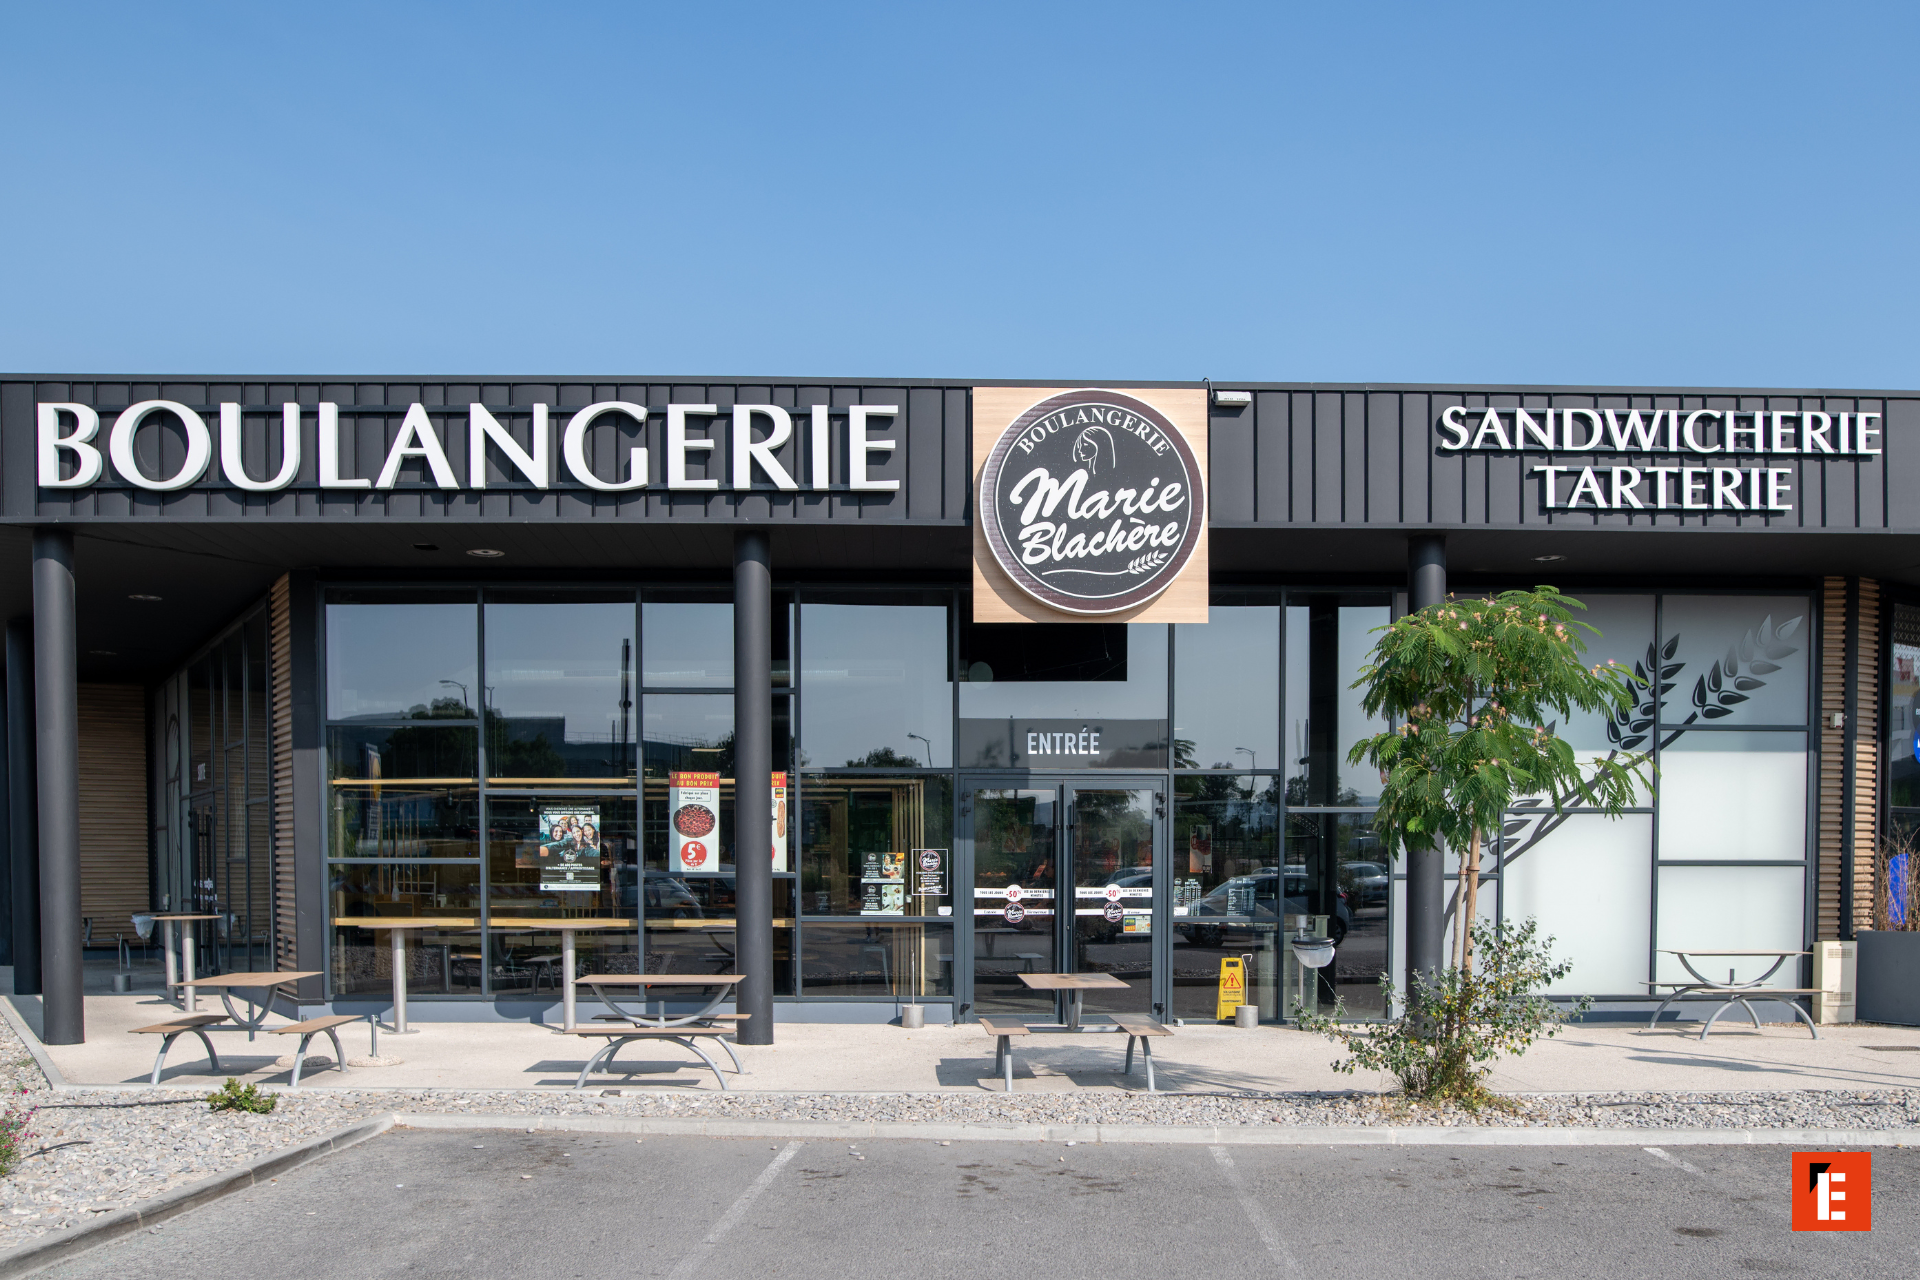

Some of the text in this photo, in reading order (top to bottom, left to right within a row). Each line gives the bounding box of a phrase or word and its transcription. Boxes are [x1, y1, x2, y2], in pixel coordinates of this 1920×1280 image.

[37, 400, 900, 491] BOULANGERIE
[1017, 407, 1170, 456] BOULANGERIE
[1441, 405, 1882, 455] SANDWICHERIE
[1010, 467, 1185, 526] Marie
[1533, 464, 1793, 511] TARTERIE
[1018, 517, 1181, 565] Blachère
[1027, 727, 1100, 755] ENTRÉE
